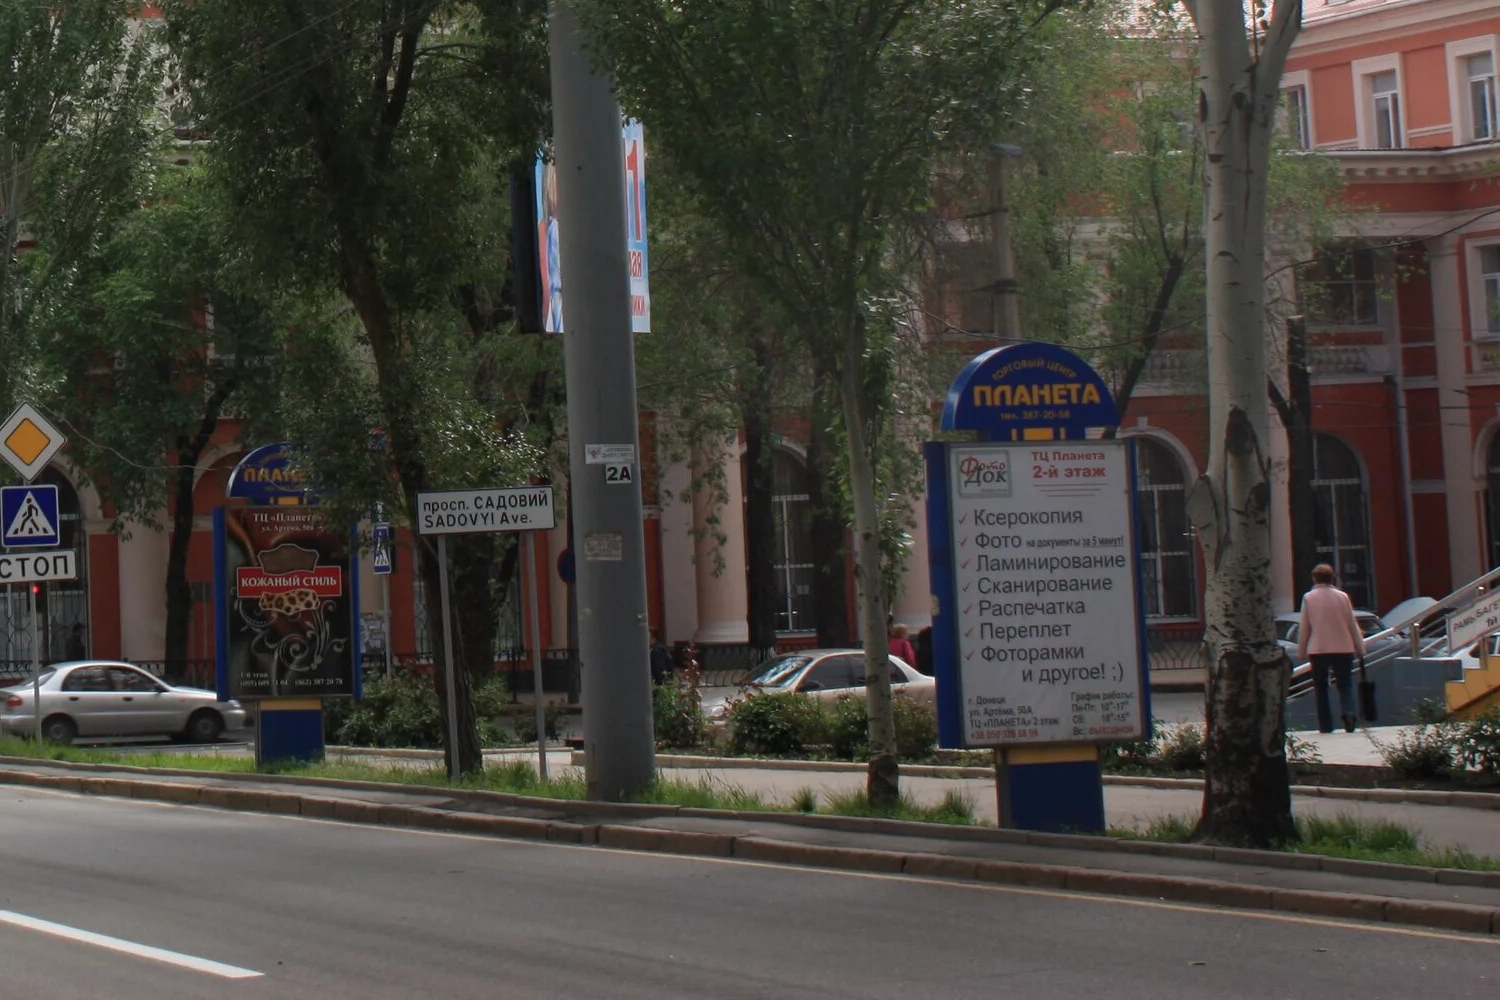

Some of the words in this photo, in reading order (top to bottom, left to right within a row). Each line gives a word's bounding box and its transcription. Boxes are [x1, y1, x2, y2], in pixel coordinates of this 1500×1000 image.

[991, 356, 1045, 381] ТОРГОВЫЙ
[1046, 360, 1077, 378] ЦЕНТР
[972, 383, 1102, 408] ПЛАНЕТА
[960, 455, 1006, 477] Фото
[1031, 451, 1049, 462] ТЦ
[1052, 450, 1106, 462] Планета
[606, 466, 631, 481] 2А
[964, 466, 1008, 488] Док
[1032, 464, 1059, 479] 2-й
[1064, 466, 1106, 478] этаж
[423, 500, 469, 515] просп.
[474, 489, 549, 511] САДОВИЙ
[252, 513, 269, 523] ТЦ
[424, 513, 495, 528] SADOVYI
[500, 511, 532, 524] Ave.
[973, 508, 1084, 529] Ксерокопия
[975, 532, 1022, 549] Фото
[1026, 540, 1036, 548] на
[1036, 538, 1080, 550] документы
[1091, 535, 1097, 546] 5
[1098, 536, 1124, 547] минут!
[976, 553, 1126, 574] Ламинирование
[241, 575, 300, 588] КОЖАНЫЙ
[302, 576, 337, 586] СТИЛЬ
[977, 576, 1113, 597] Сканирование
[978, 599, 1086, 617] Распечатка
[980, 622, 1072, 643] Переплет
[981, 645, 1084, 665] Фоторамки
[1022, 669, 1033, 682] и
[1038, 662, 1106, 685] другое!
